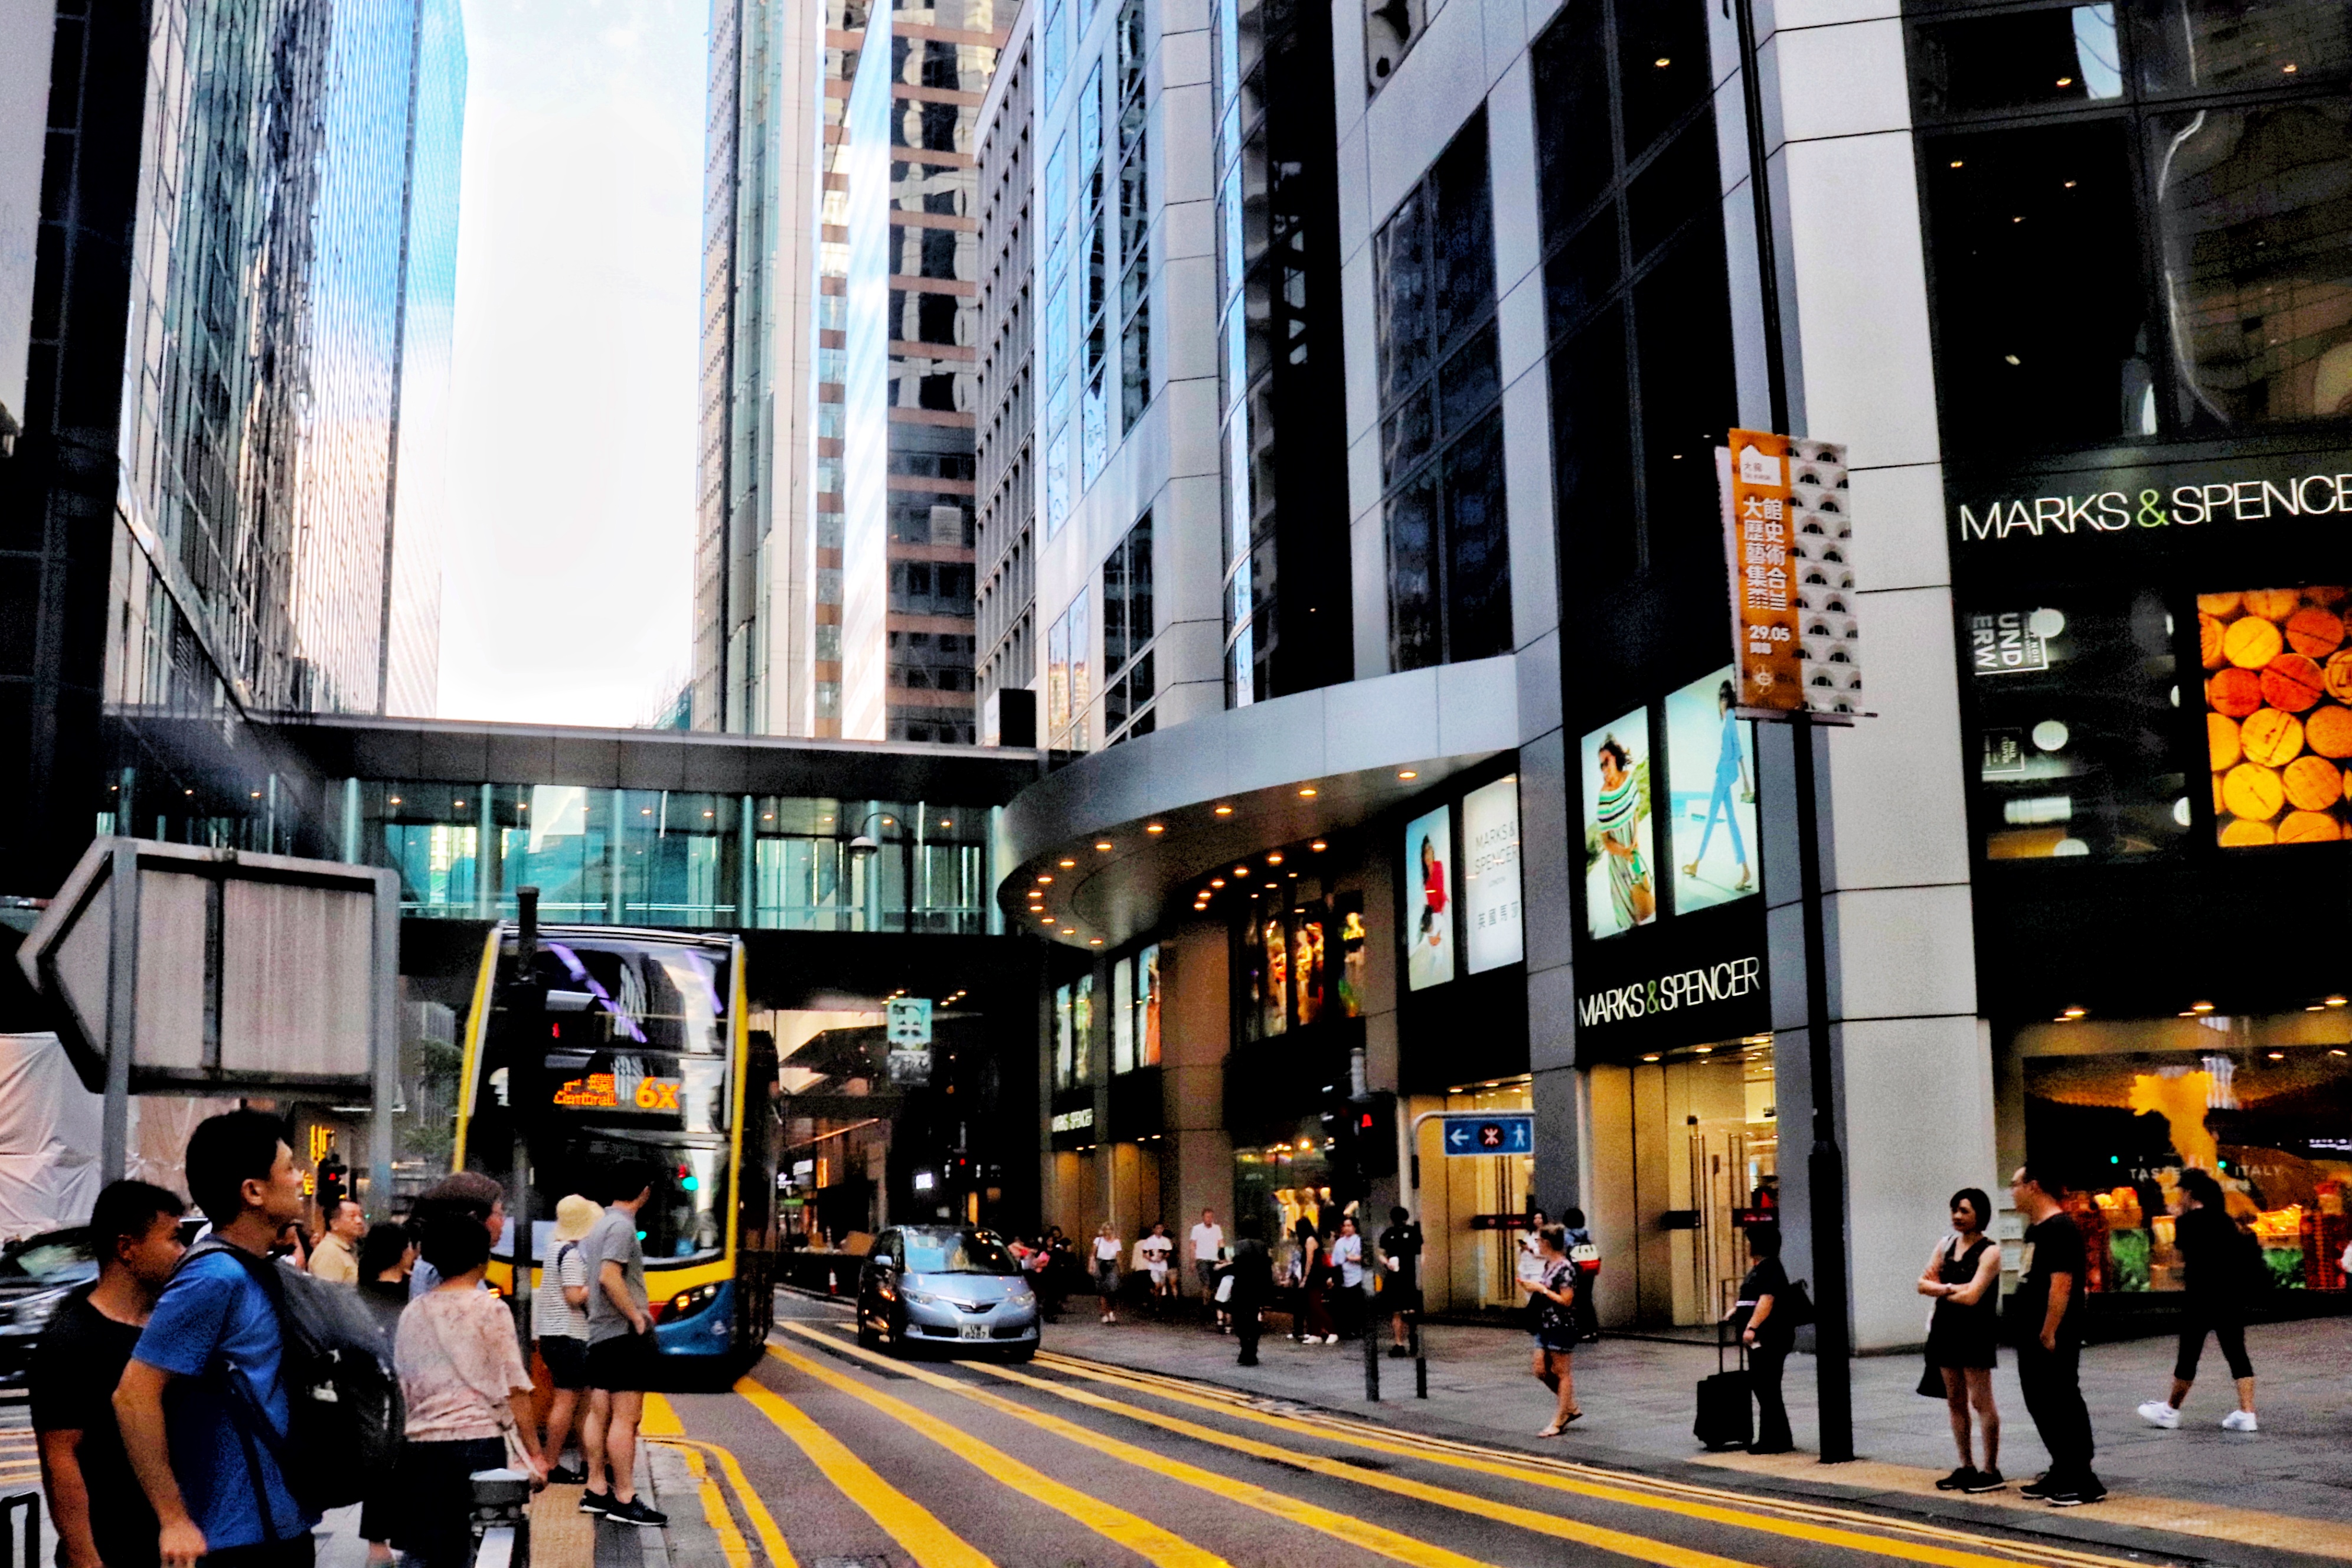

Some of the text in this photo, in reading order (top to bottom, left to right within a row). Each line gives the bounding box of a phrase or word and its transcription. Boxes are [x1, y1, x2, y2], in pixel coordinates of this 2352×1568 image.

[1743, 496, 1783, 520] 大館
[1749, 625, 1791, 642] 29.05
[1475, 824, 1507, 851] MARKS
[1475, 844, 1519, 875] SPENCER
